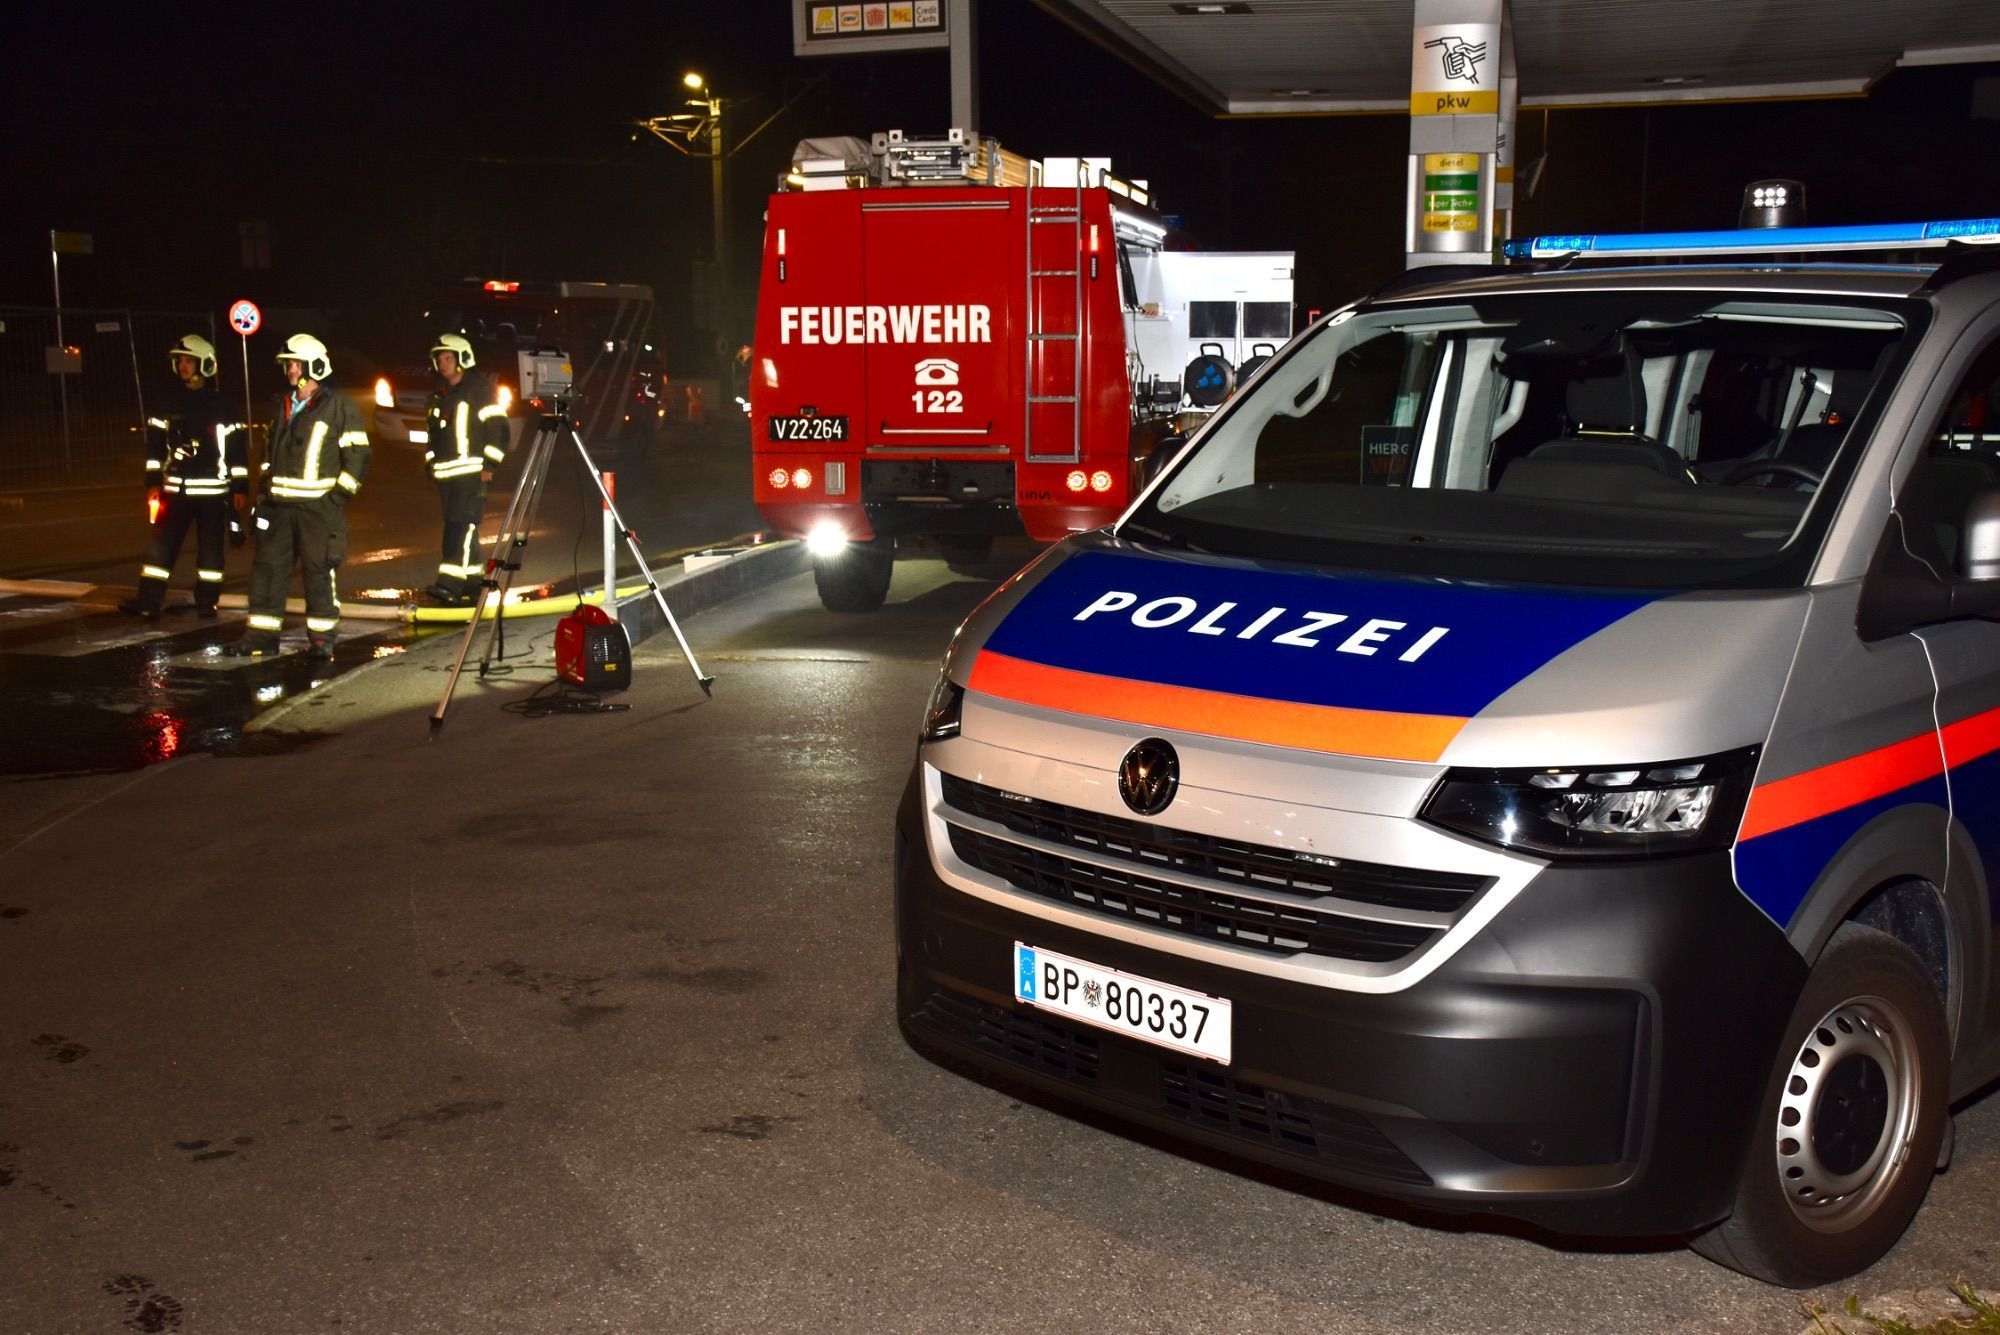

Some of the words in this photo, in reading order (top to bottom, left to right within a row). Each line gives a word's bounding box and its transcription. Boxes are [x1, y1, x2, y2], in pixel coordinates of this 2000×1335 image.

[916, 6, 937, 15] Credit
[917, 15, 937, 24] Cards
[1436, 93, 1471, 112] pkw
[1440, 159, 1464, 167] diesel
[780, 304, 992, 345] FEUERWEHR
[911, 390, 964, 413] 122
[774, 419, 787, 439] V
[1369, 443, 1399, 455] HIER
[1072, 590, 1450, 663] POLIZEI
[1023, 982, 1032, 993] A
[1044, 962, 1079, 1005] BP
[1105, 981, 1210, 1044] 80337
